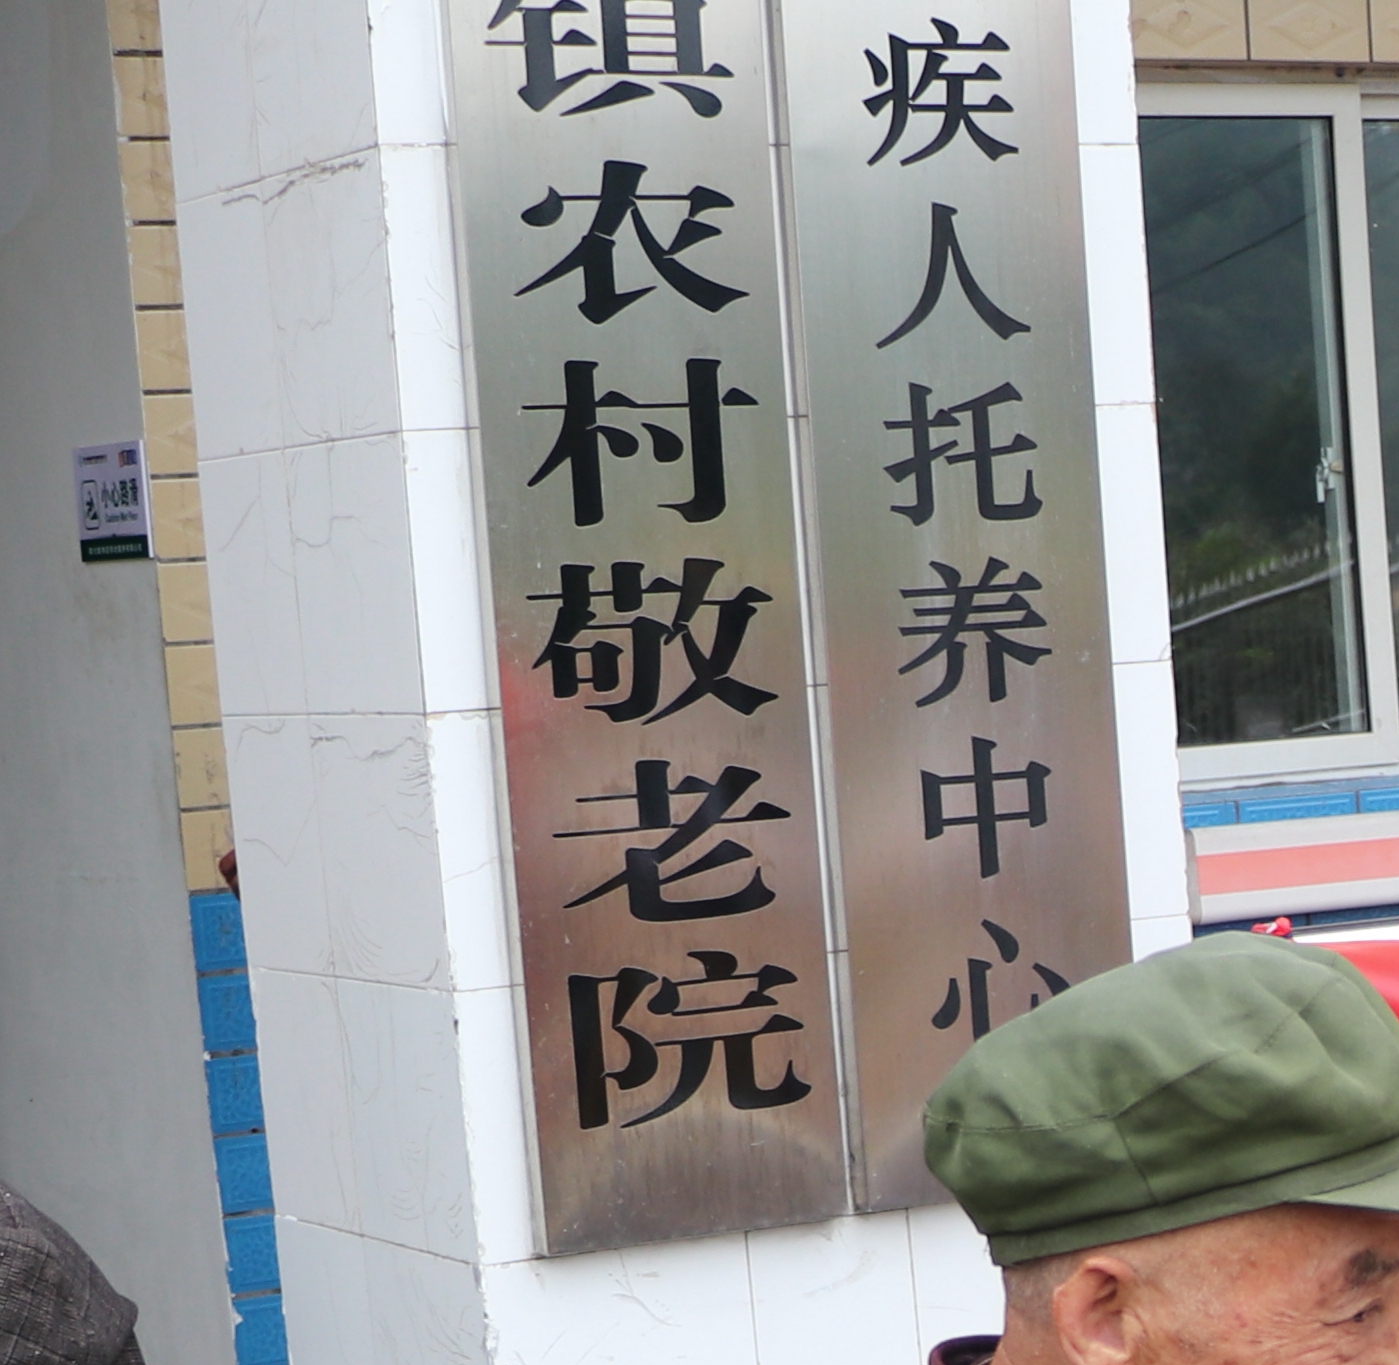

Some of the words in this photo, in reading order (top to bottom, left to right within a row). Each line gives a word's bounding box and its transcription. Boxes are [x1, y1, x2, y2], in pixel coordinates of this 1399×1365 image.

[483, 0, 812, 1131] 镇农村敬老院
[862, 17, 1072, 1043] 疾人托养中心
